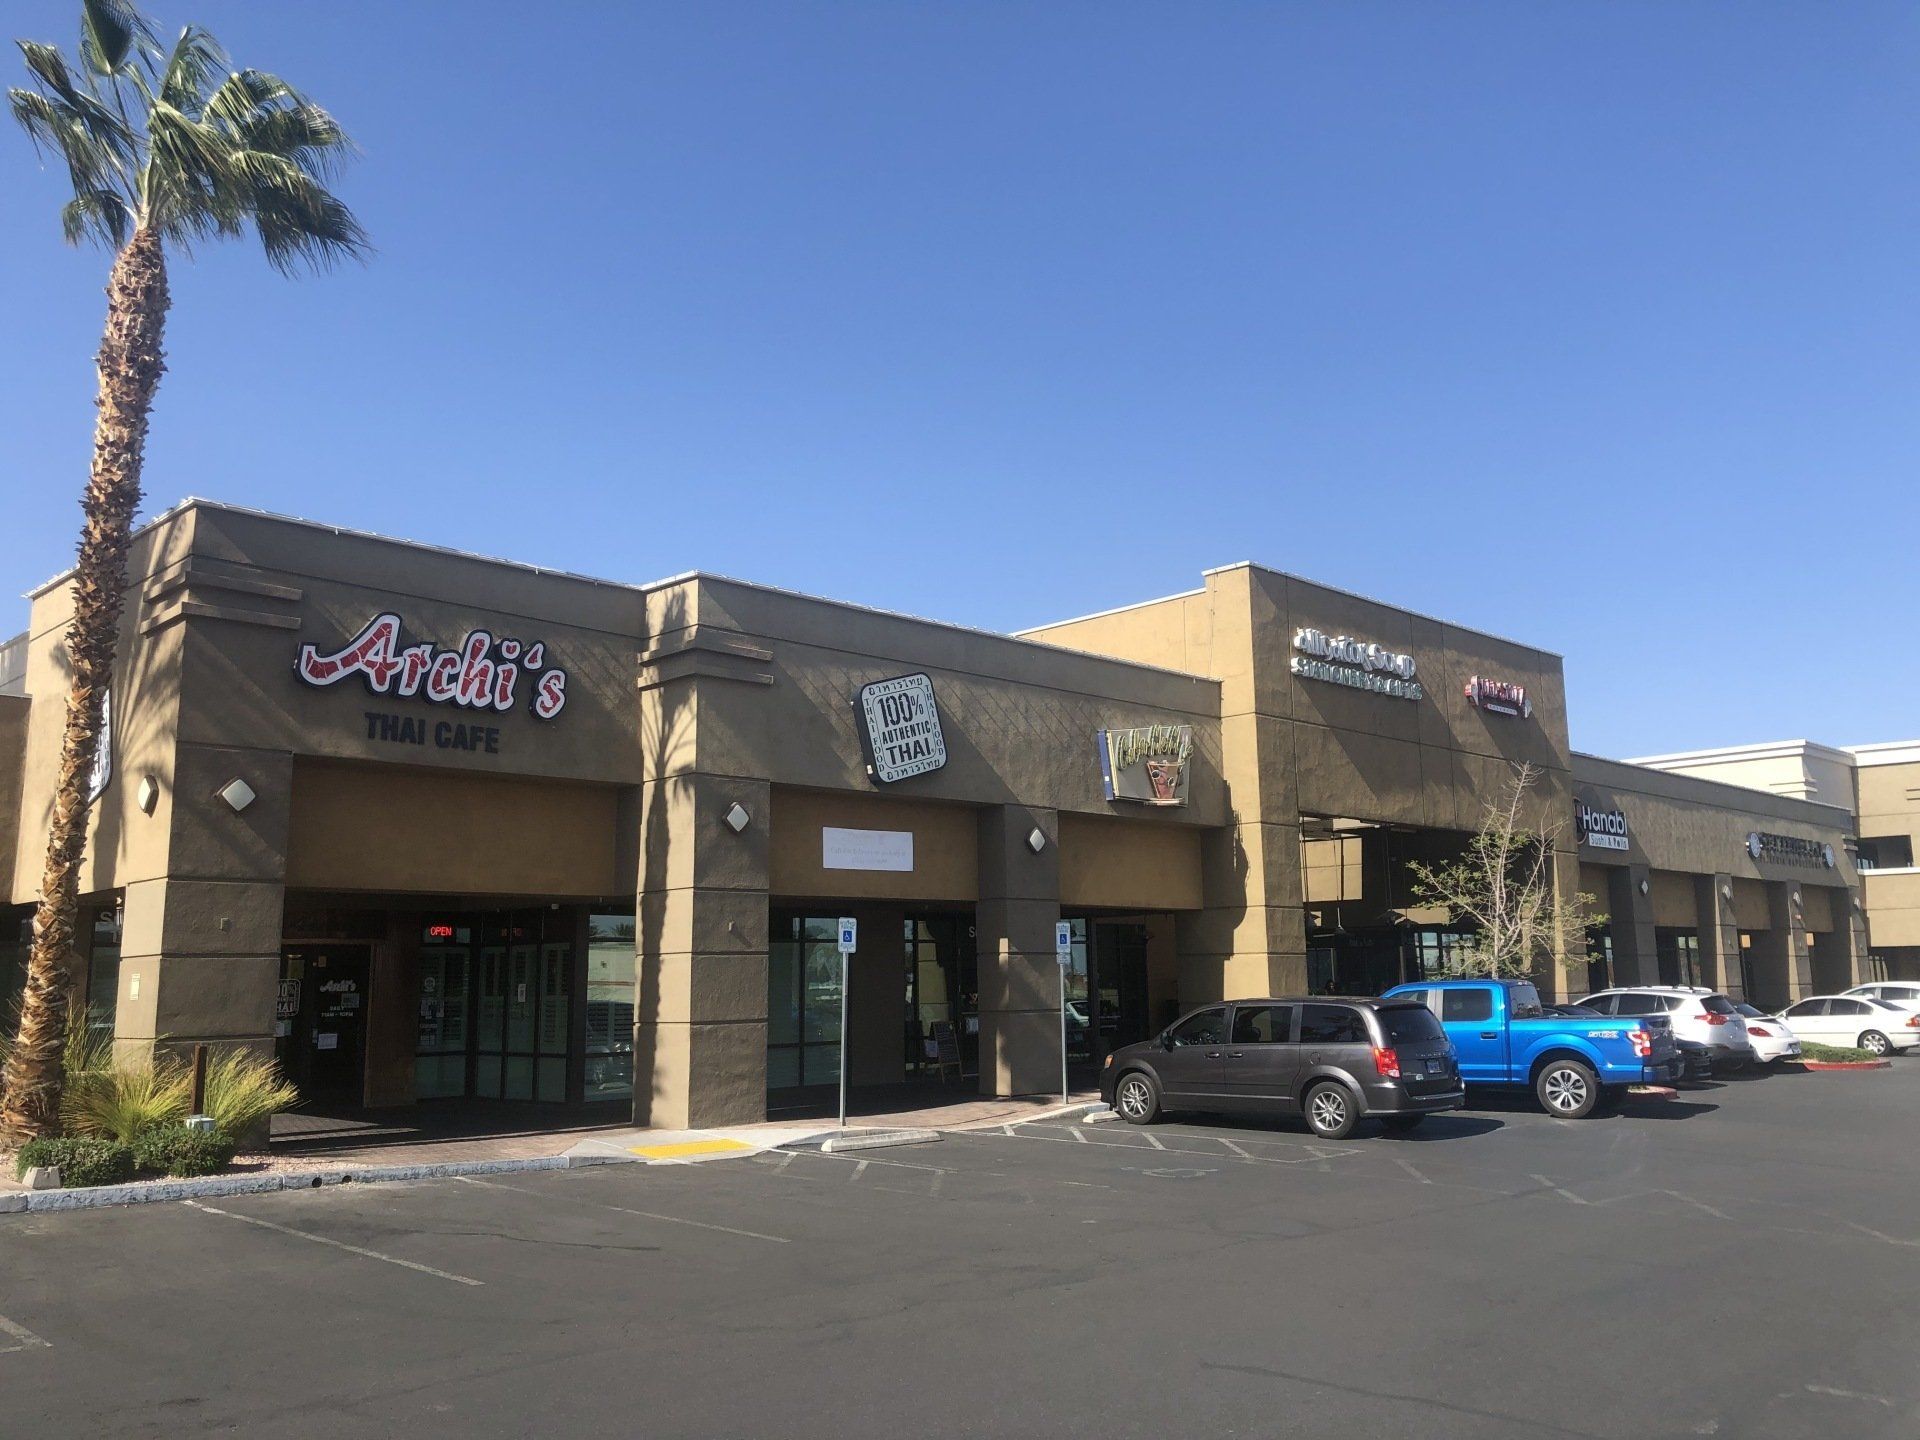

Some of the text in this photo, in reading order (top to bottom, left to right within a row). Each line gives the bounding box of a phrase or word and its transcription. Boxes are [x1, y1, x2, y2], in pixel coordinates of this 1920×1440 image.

[300, 612, 566, 720] Archi's
[877, 692, 924, 728] 100%
[924, 684, 945, 756] THAI FOOD
[364, 712, 500, 754] THAI CAFE
[863, 698, 886, 772] THAI FOOD
[881, 720, 932, 745] AUTHENTIC
[885, 737, 932, 766] THAI
[1582, 805, 1628, 836] Hanabi
[430, 925, 452, 937] OPEN
